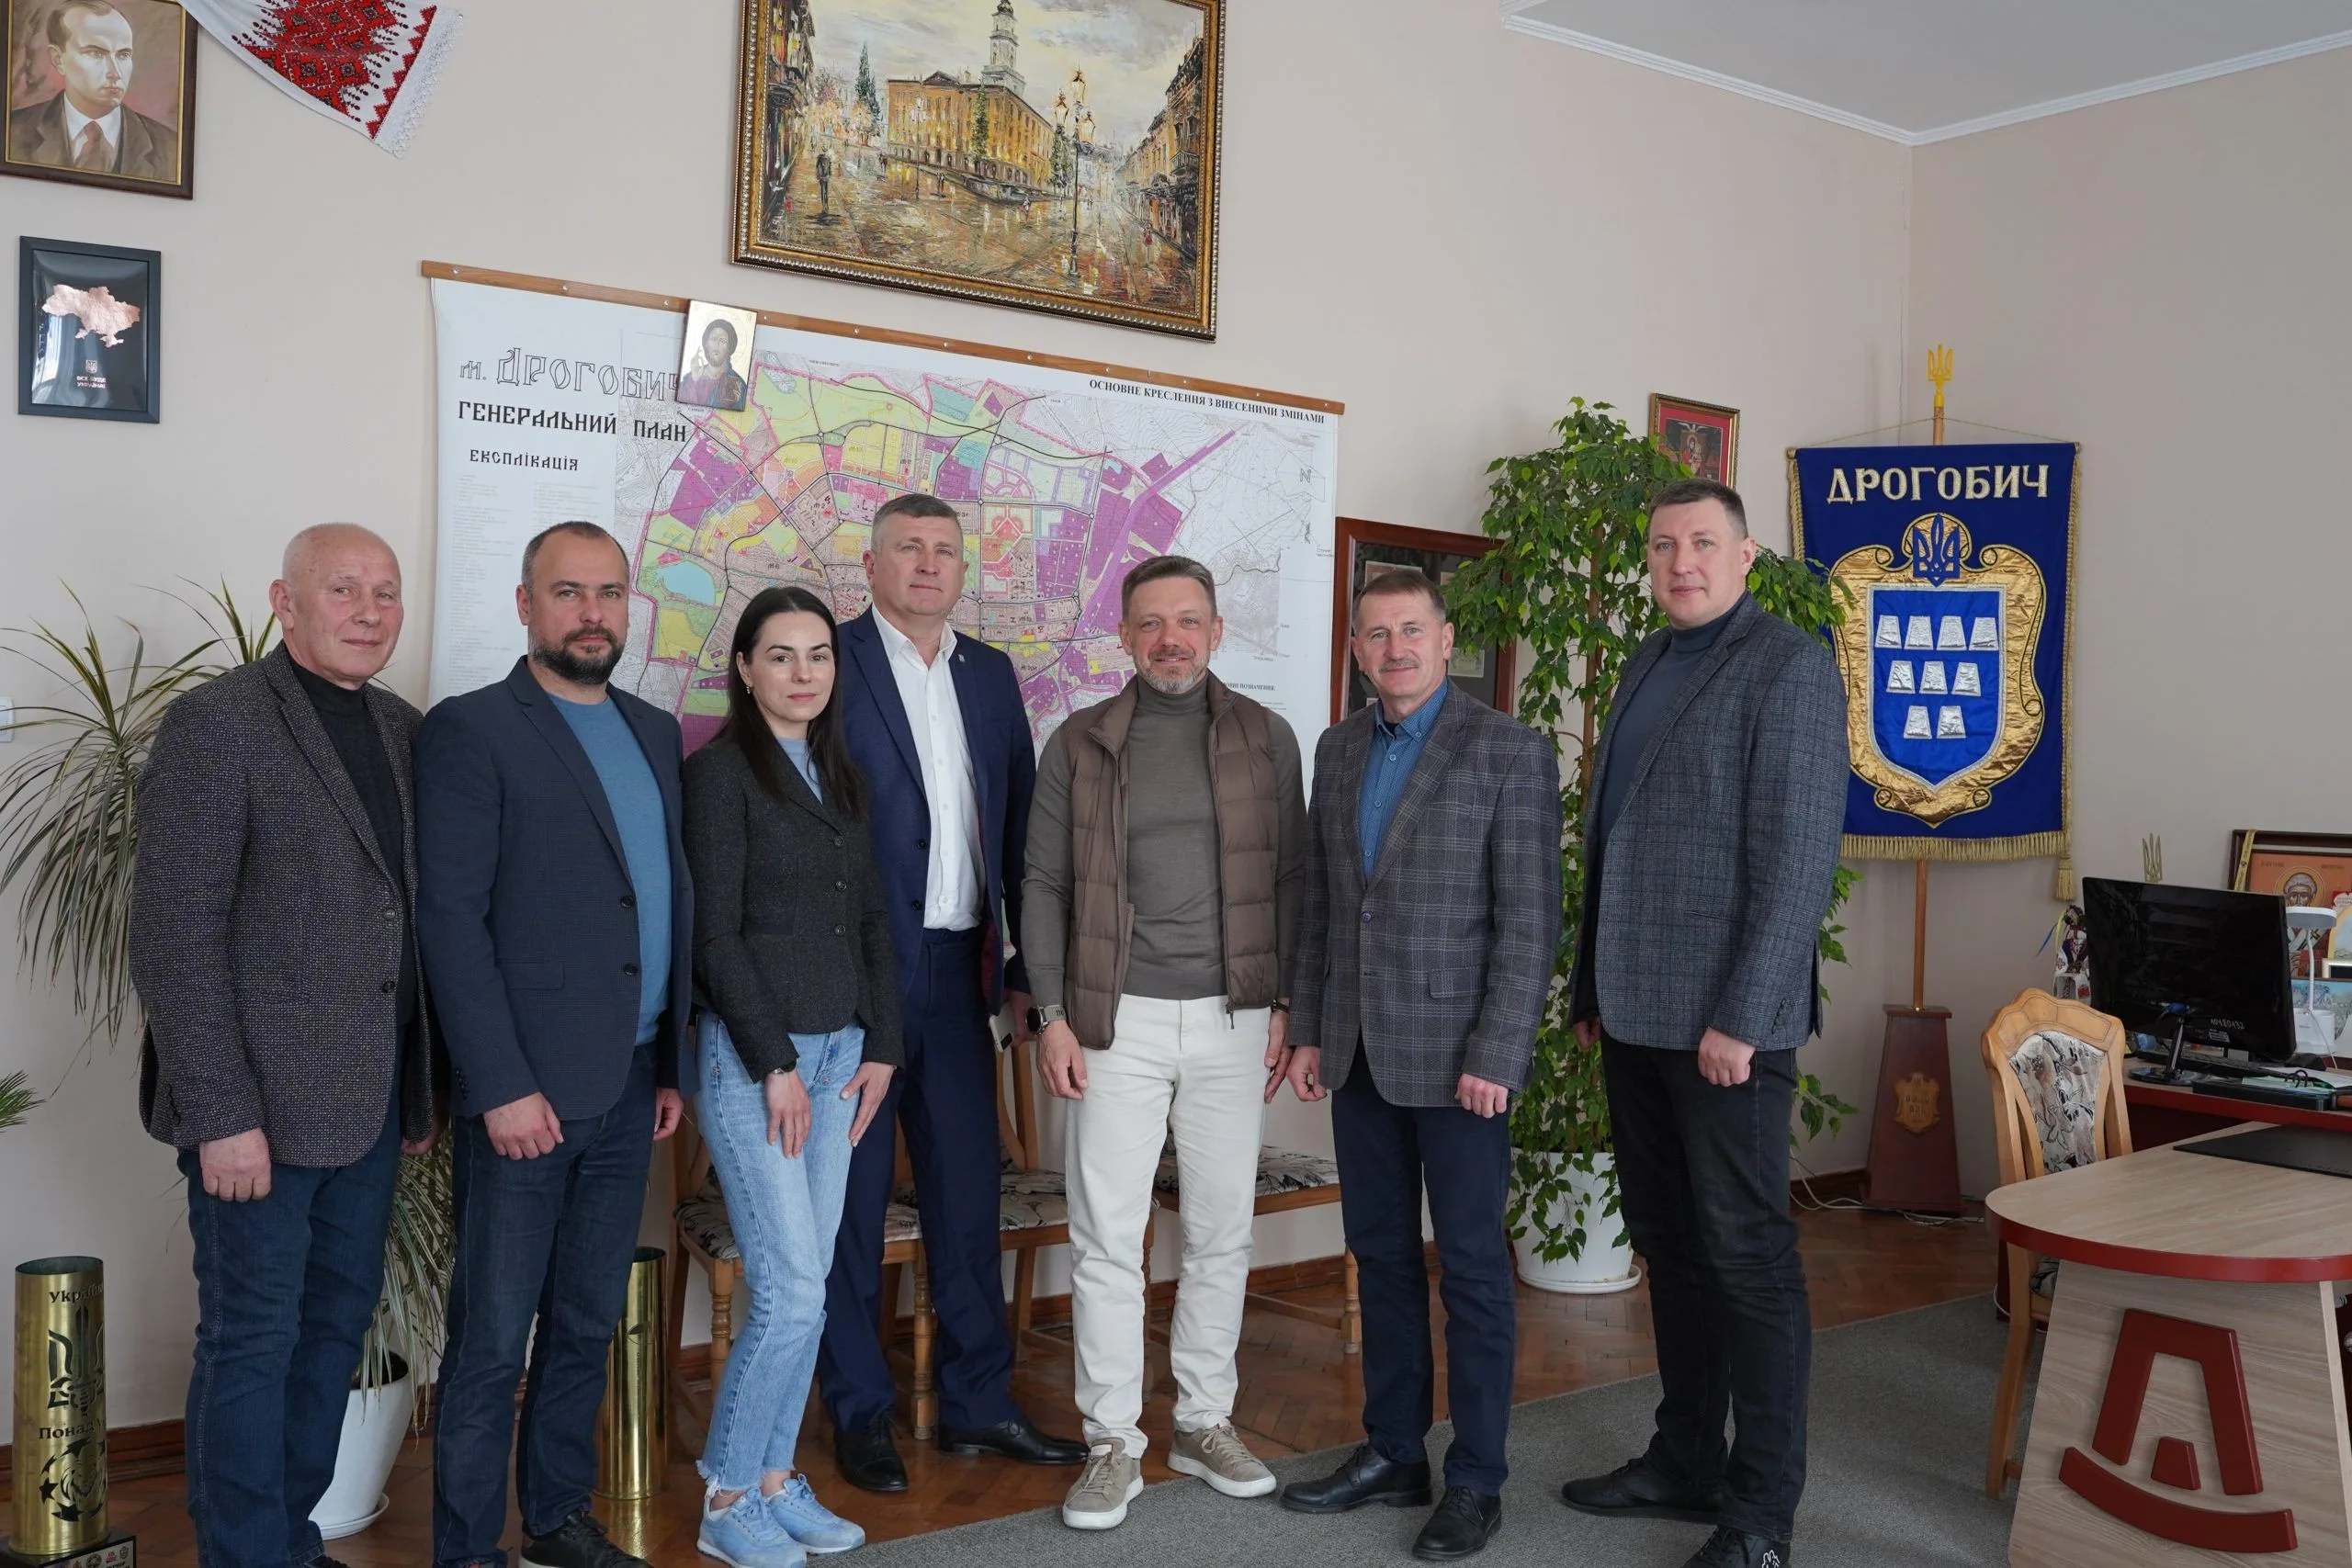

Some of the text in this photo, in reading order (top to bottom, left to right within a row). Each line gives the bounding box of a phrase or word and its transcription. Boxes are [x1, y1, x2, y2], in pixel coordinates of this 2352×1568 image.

[458, 400, 686, 442] ГЕНЕРАЛЬНИЙ ПЛАН
[1089, 379, 1141, 396] ОСНОВНЕ
[1144, 388, 1205, 406] КРЕСЛЕННЯ
[1215, 399, 1278, 417] ВНЕСЕНИМИ
[1280, 408, 1325, 423] ЗМІНАМИ
[469, 449, 578, 471] ЕКСПЛІКАЦІЯ
[1826, 464, 2049, 504] ДРОГОБИЧ
